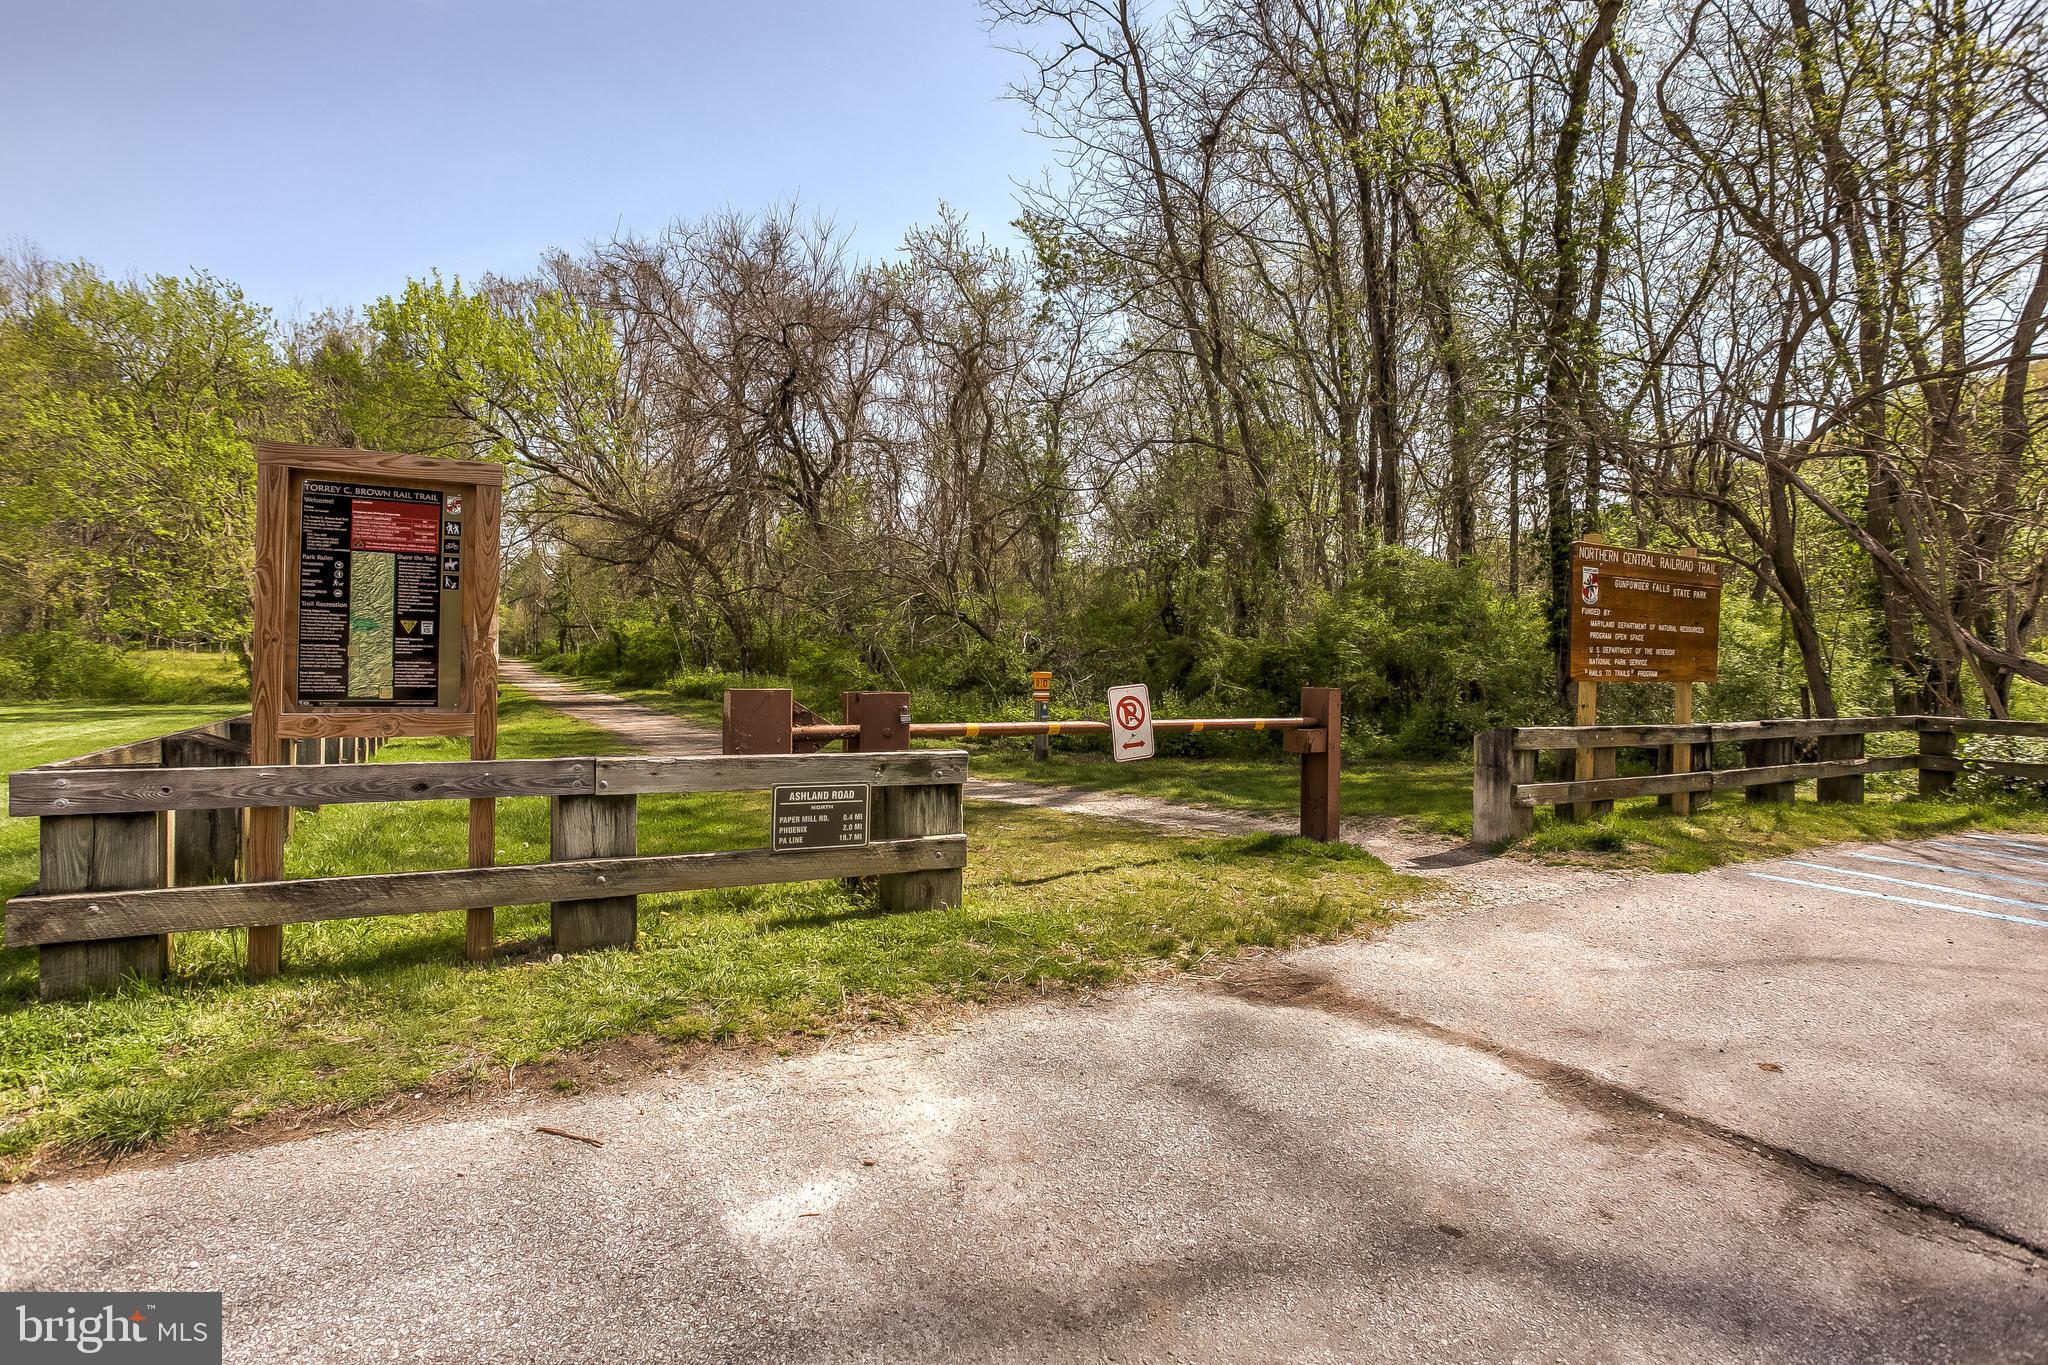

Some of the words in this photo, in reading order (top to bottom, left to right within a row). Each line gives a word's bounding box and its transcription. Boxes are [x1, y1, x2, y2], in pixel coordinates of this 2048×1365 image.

[304, 483, 341, 493] TORREY
[354, 487, 390, 497] BROWN
[393, 490, 412, 499] RAIL
[414, 492, 438, 501] TRAIL
[303, 496, 334, 504] Welcome!
[1579, 547, 1619, 562] NORTHERN
[1622, 552, 1656, 568] CENTRAL
[1659, 557, 1694, 572] RAILROAD
[1697, 562, 1717, 575] TRAIL
[1614, 579, 1649, 591] GUNPOWDER
[1652, 583, 1670, 593] FALLS
[1673, 588, 1691, 598] STATE
[1693, 590, 1707, 599] PARK
[1581, 607, 1600, 616] FUNDED
[1590, 620, 1615, 628] MARYLAND
[1618, 621, 1647, 630] DEPARTMENT
[1658, 624, 1677, 632] NATURAL
[1680, 625, 1704, 634] RESOURCES
[1589, 631, 1612, 640] PROGRAM
[1615, 633, 1627, 641] OPEN
[1602, 646, 1632, 655] DEPARTMENT
[1635, 647, 1641, 655] OF
[1655, 648, 1675, 656] INTERIOR
[1588, 657, 1611, 666] NATIONAL
[1614, 658, 1626, 666] PARK
[1637, 669, 1658, 678] PROGRAM
[789, 791, 829, 801] ASHLAND
[831, 790, 855, 800] ROAD
[779, 816, 800, 824] PAPER
[801, 815, 817, 823] MILL
[778, 825, 807, 834] PHOENIX
[842, 823, 853, 831] 2.0
[778, 837, 787, 845] PA
[788, 836, 804, 844] LINE
